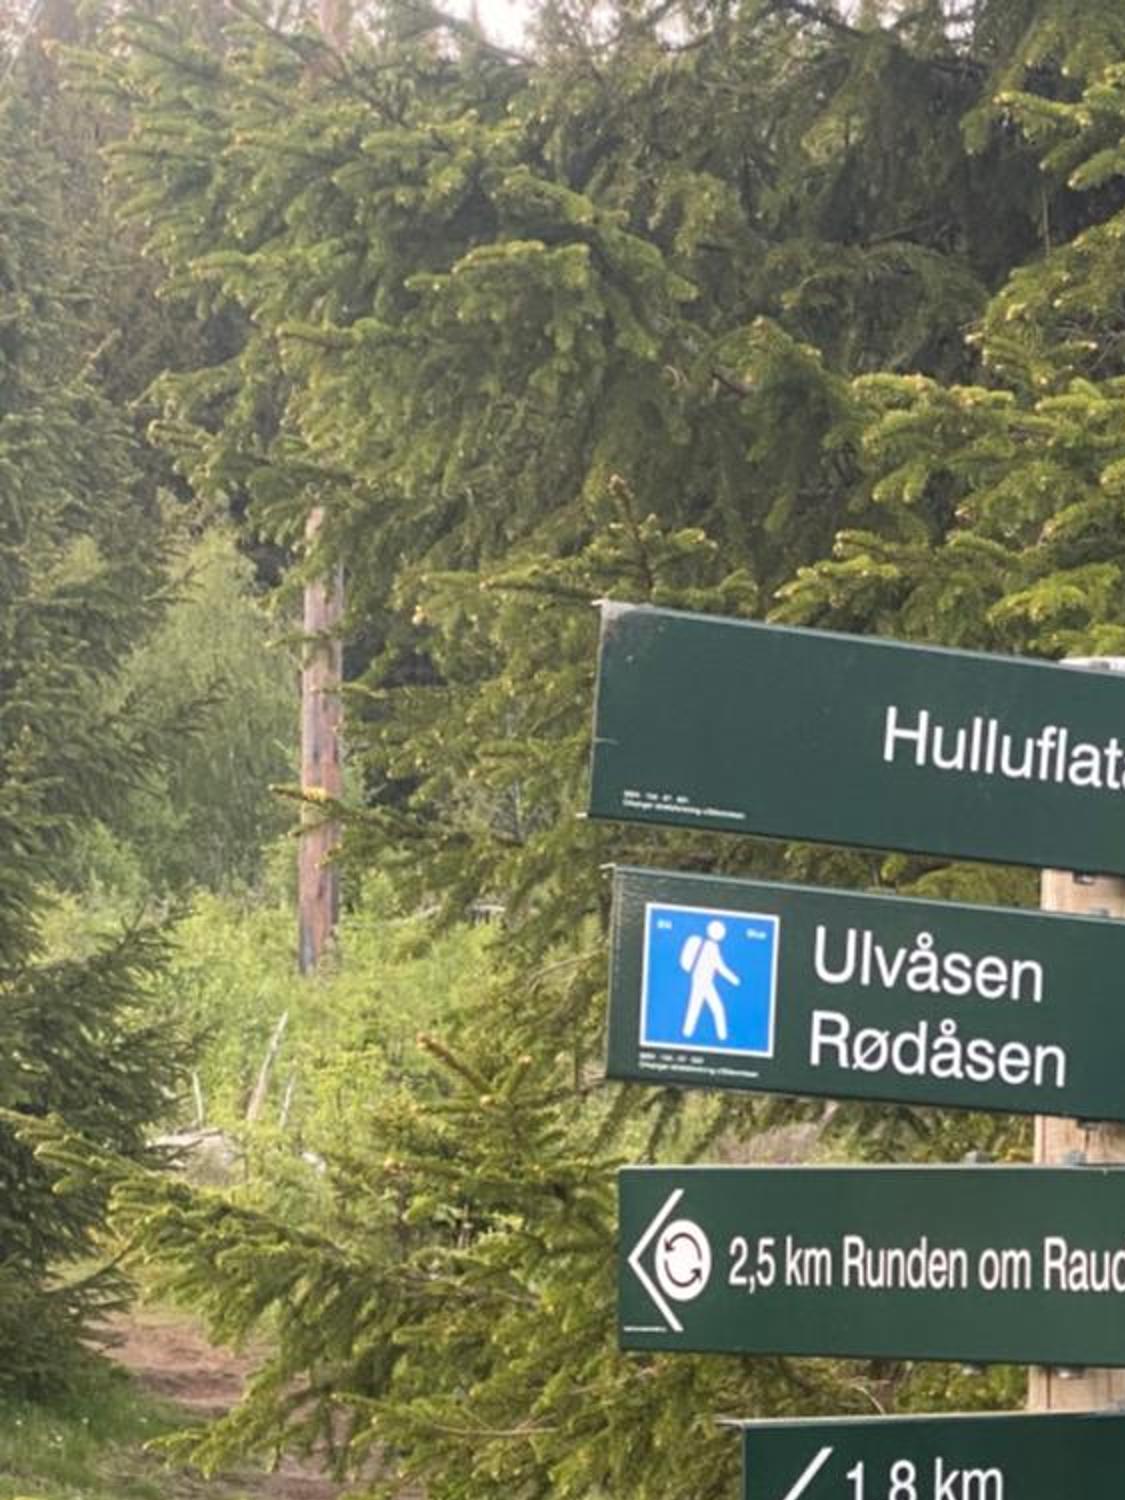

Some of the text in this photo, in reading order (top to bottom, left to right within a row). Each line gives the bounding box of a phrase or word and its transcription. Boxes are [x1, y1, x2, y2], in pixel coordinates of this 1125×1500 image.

[814, 925, 1043, 1003] Ulvåsen
[810, 1010, 1066, 1088] Rødåsen
[729, 1236, 776, 1294] 2,5
[785, 1235, 832, 1286] km
[843, 1235, 968, 1289] Runden
[978, 1248, 1031, 1290] om
